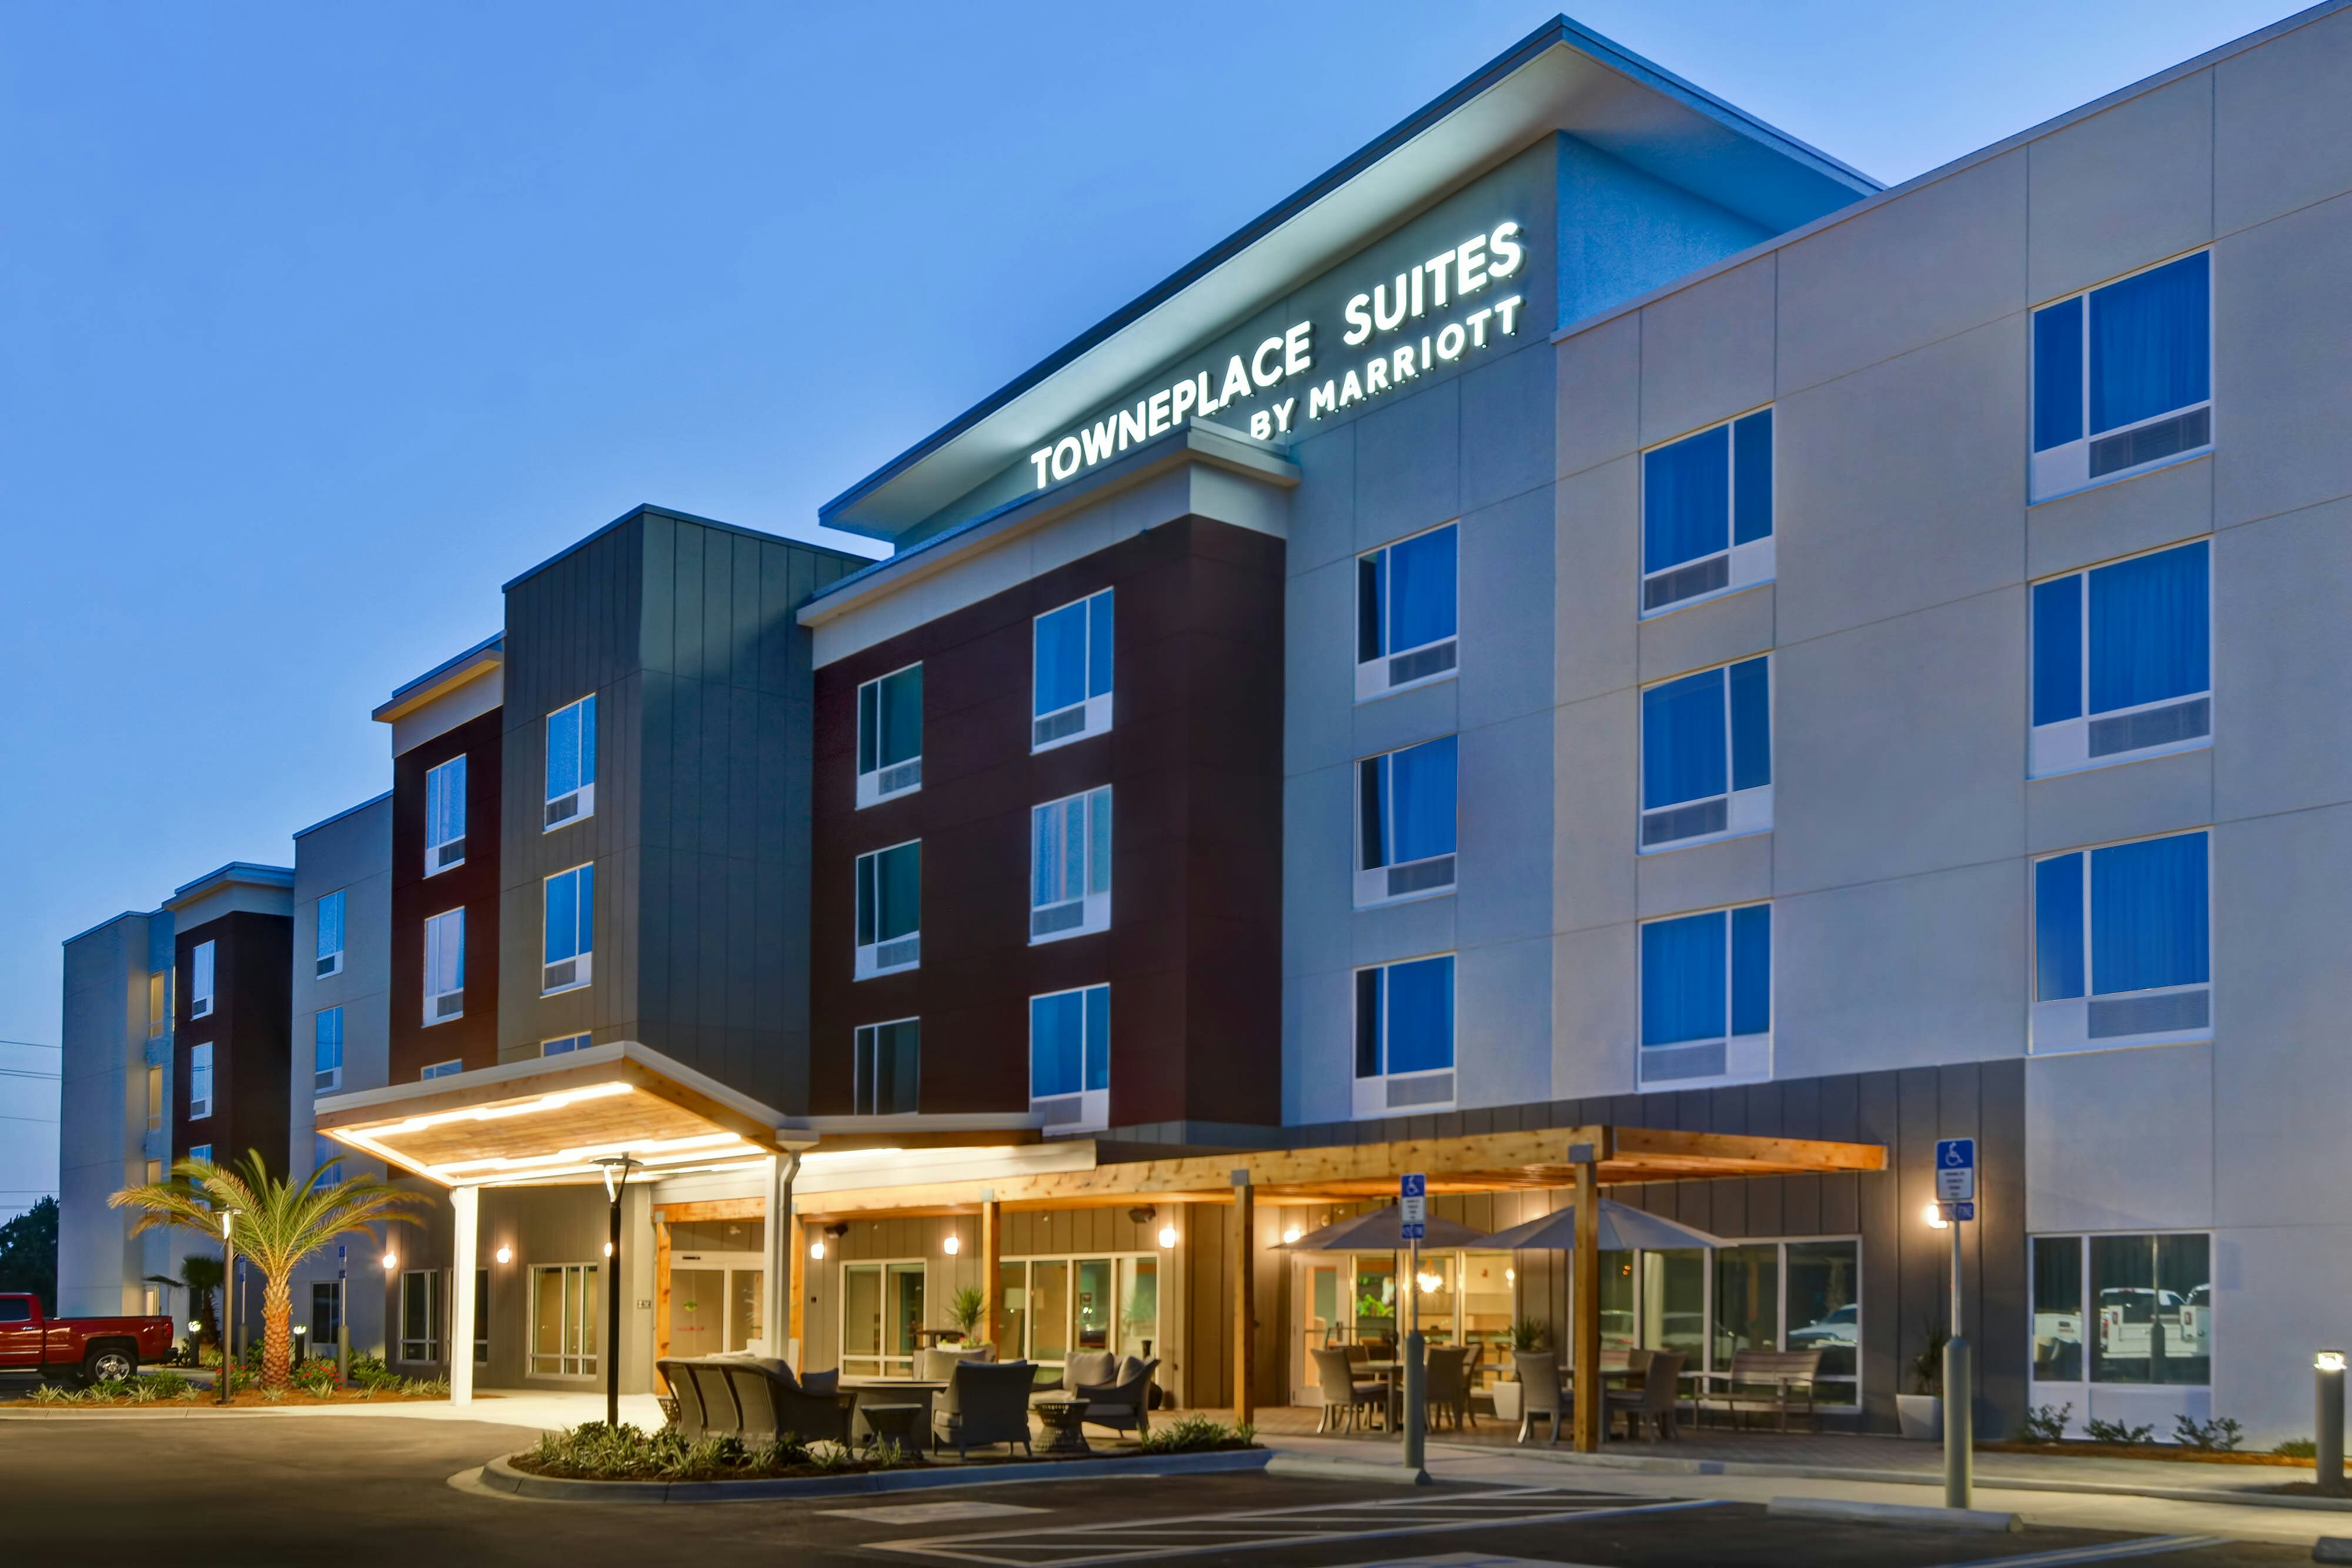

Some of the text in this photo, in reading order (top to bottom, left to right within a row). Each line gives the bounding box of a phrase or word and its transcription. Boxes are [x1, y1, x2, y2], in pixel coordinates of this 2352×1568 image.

[1030, 222, 1522, 489] TOWNEPLACE SUITES
[1250, 295, 1521, 440] BY MARRIOTT
